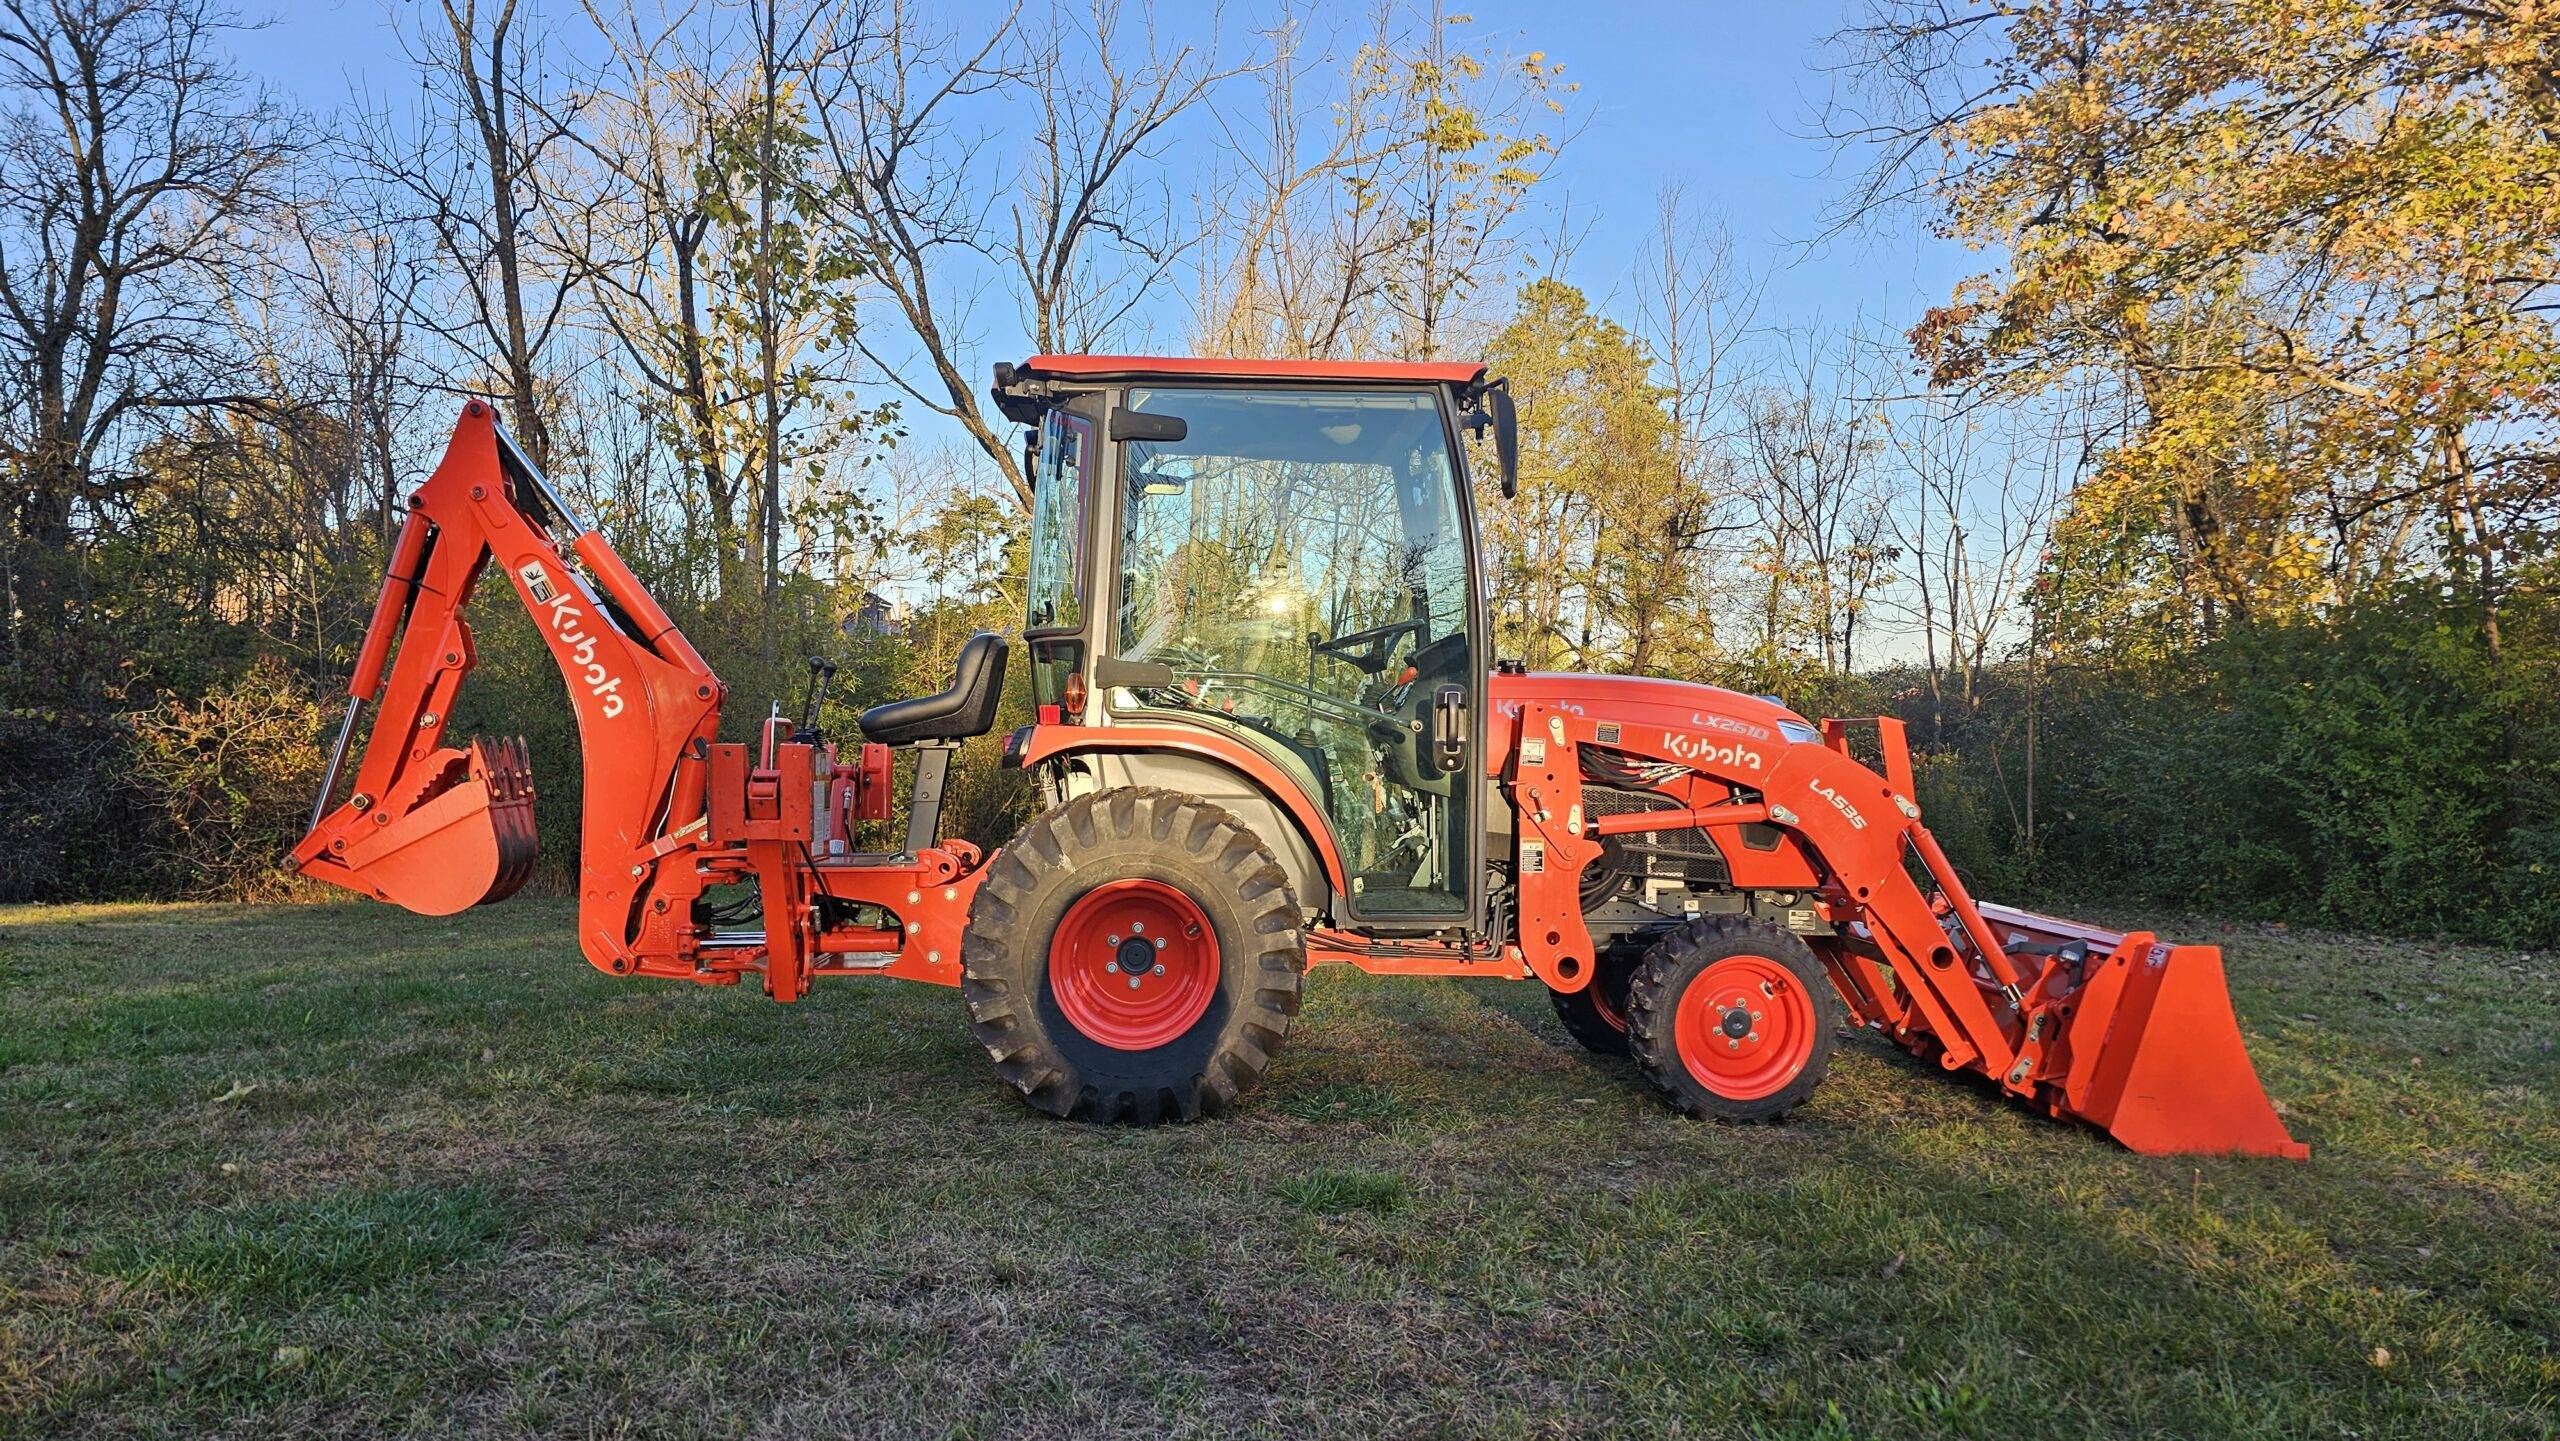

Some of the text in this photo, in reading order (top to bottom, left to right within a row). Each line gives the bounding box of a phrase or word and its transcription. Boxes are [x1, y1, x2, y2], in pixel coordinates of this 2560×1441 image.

[550, 593, 624, 719] Kubota
[1692, 712, 1770, 741] LX2610
[1663, 732, 1761, 770] Kubota
[1809, 778, 1868, 830] LA535
